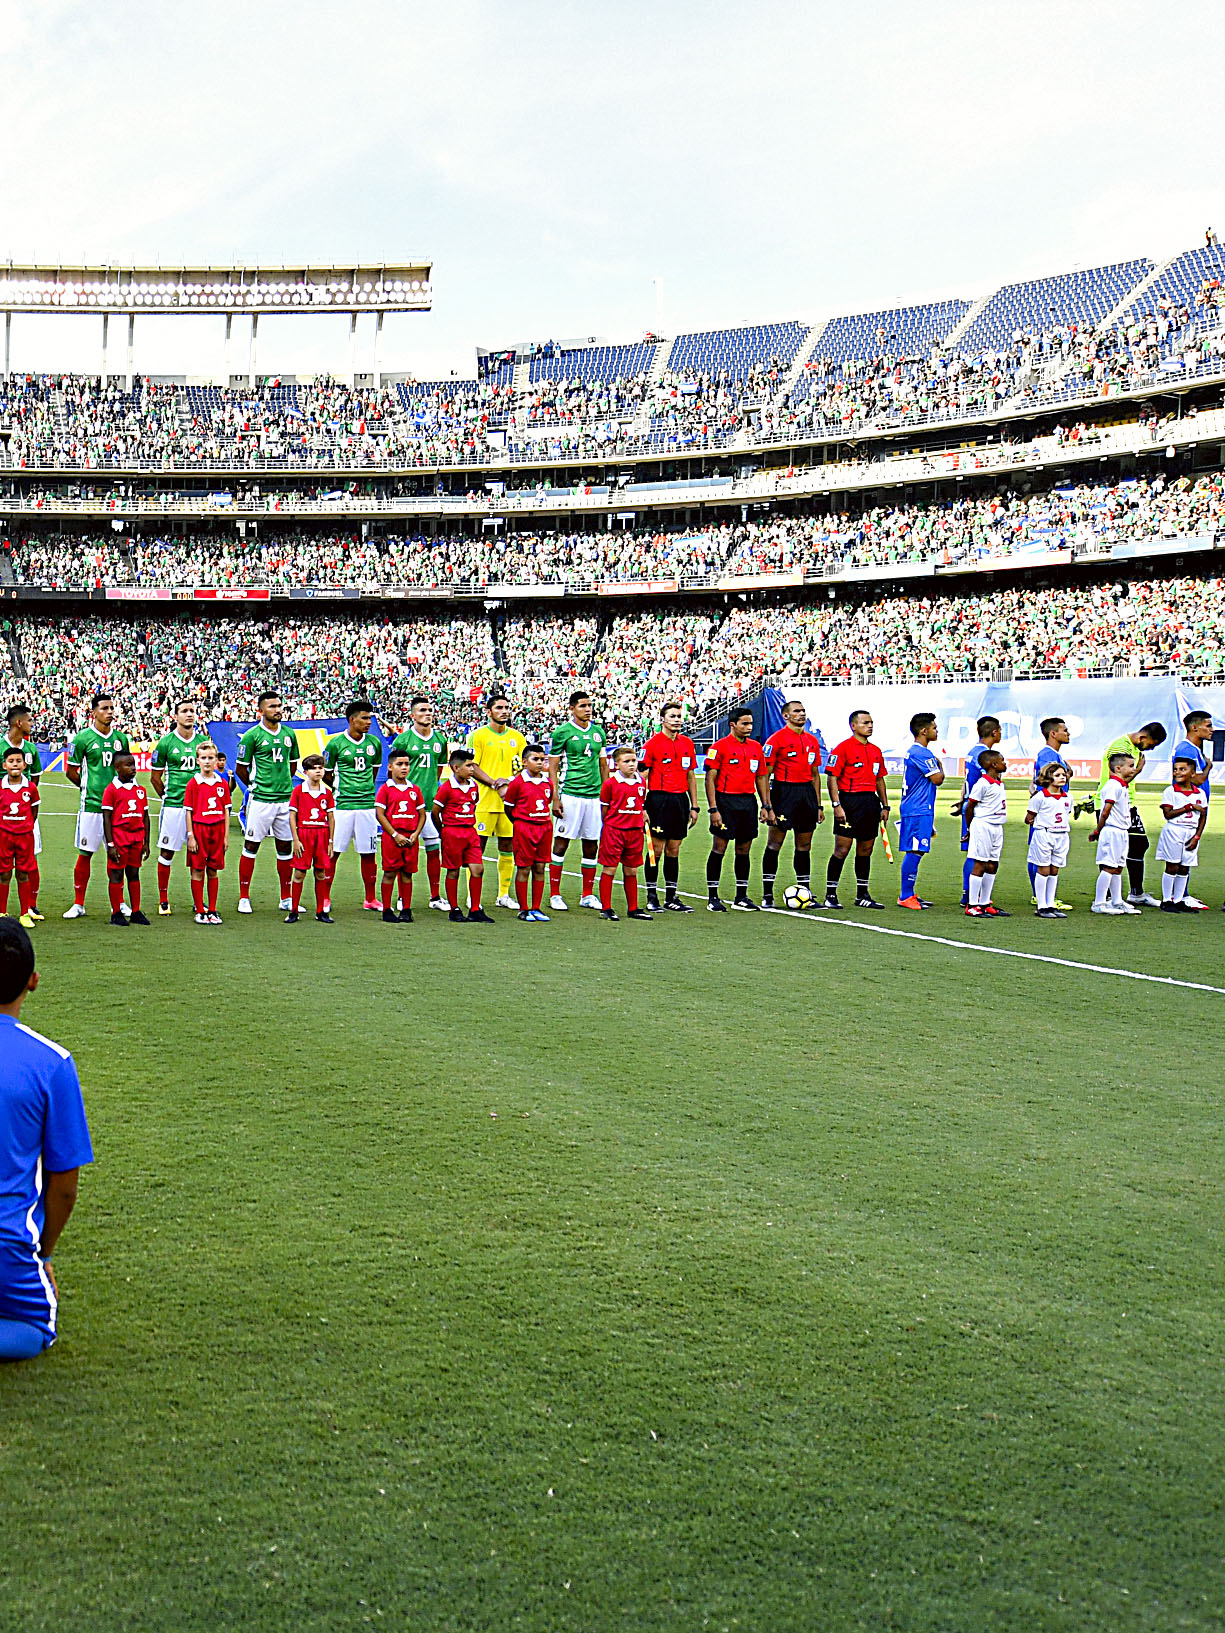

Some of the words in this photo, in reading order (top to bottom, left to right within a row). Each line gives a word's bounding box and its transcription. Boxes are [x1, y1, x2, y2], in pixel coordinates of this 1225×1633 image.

[120, 590, 158, 598] TOYOTA
[272, 747, 283, 763] 14
[583, 743, 591, 758] 4
[102, 751, 113, 767] 19
[180, 755, 196, 770] 20
[353, 756, 366, 771] 18
[419, 753, 431, 768] 21
